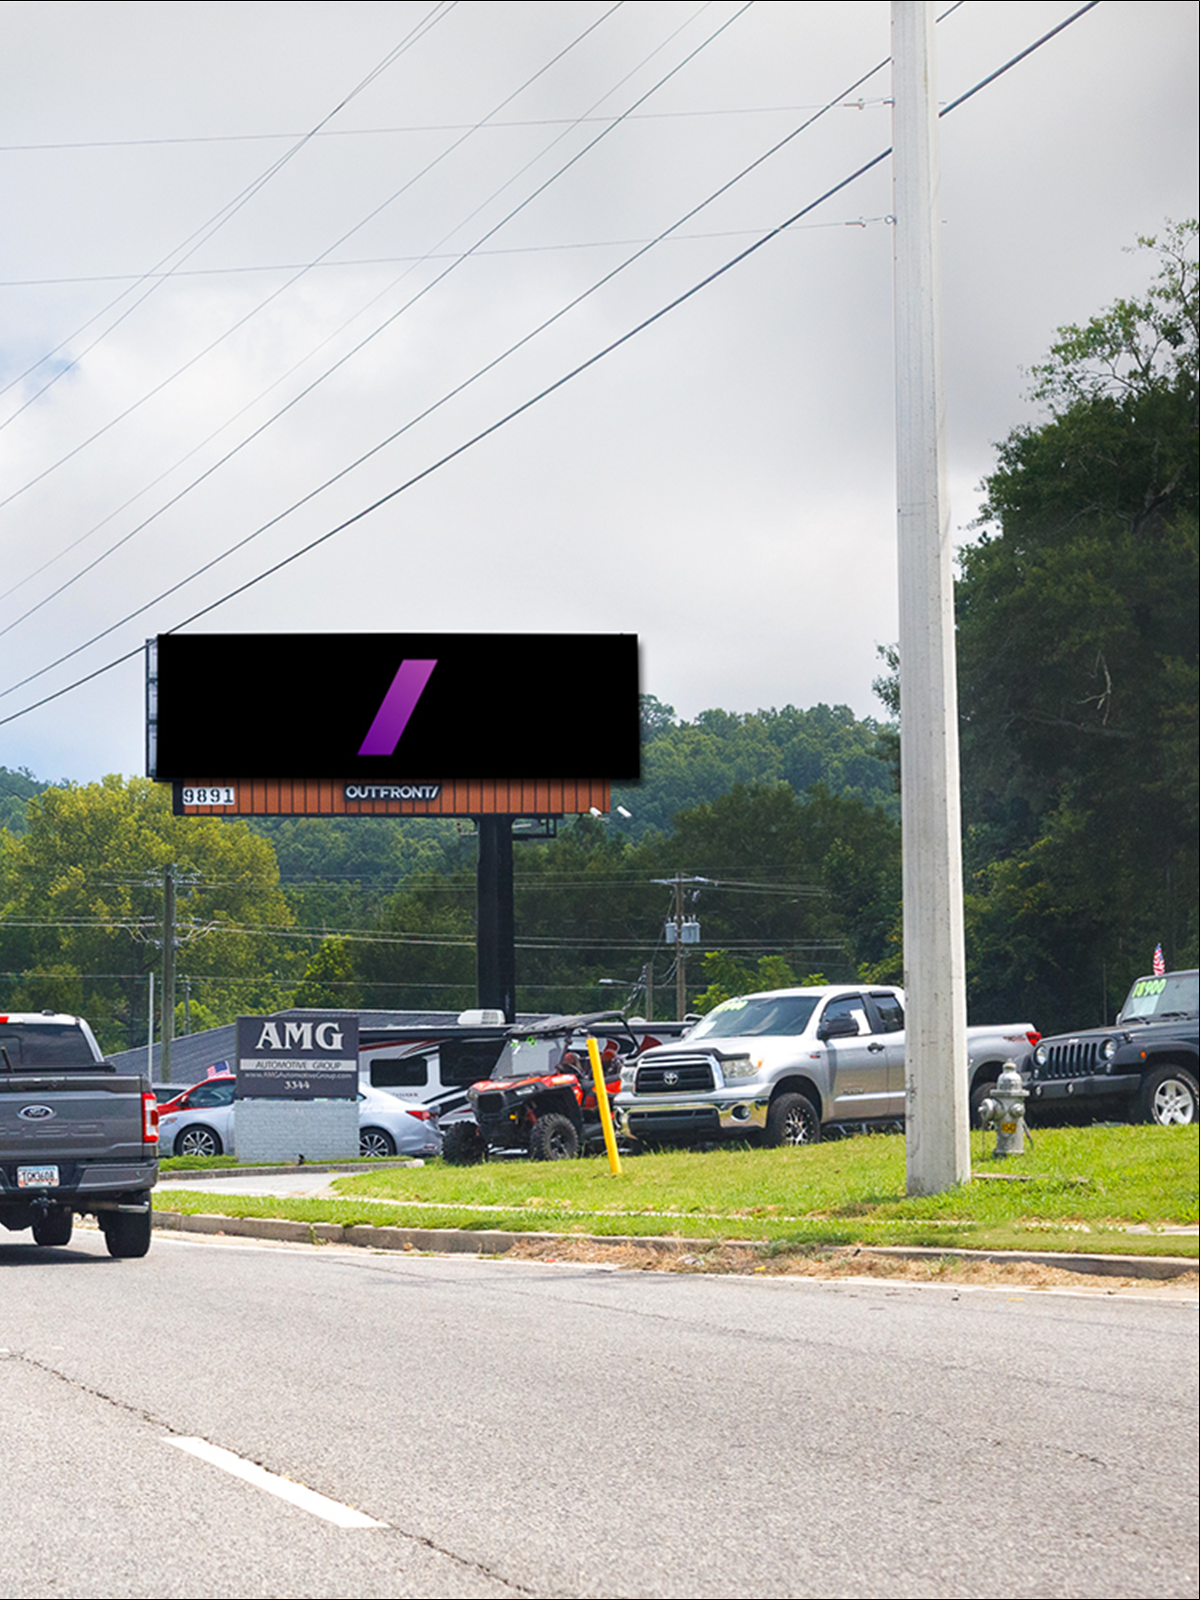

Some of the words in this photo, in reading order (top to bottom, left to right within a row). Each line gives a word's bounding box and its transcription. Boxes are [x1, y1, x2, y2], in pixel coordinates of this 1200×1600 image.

[184, 788, 234, 803] 9891
[255, 1022, 344, 1051] AMG
[255, 1061, 307, 1069] AUTOMOTIVE
[312, 1061, 342, 1070] GROUP
